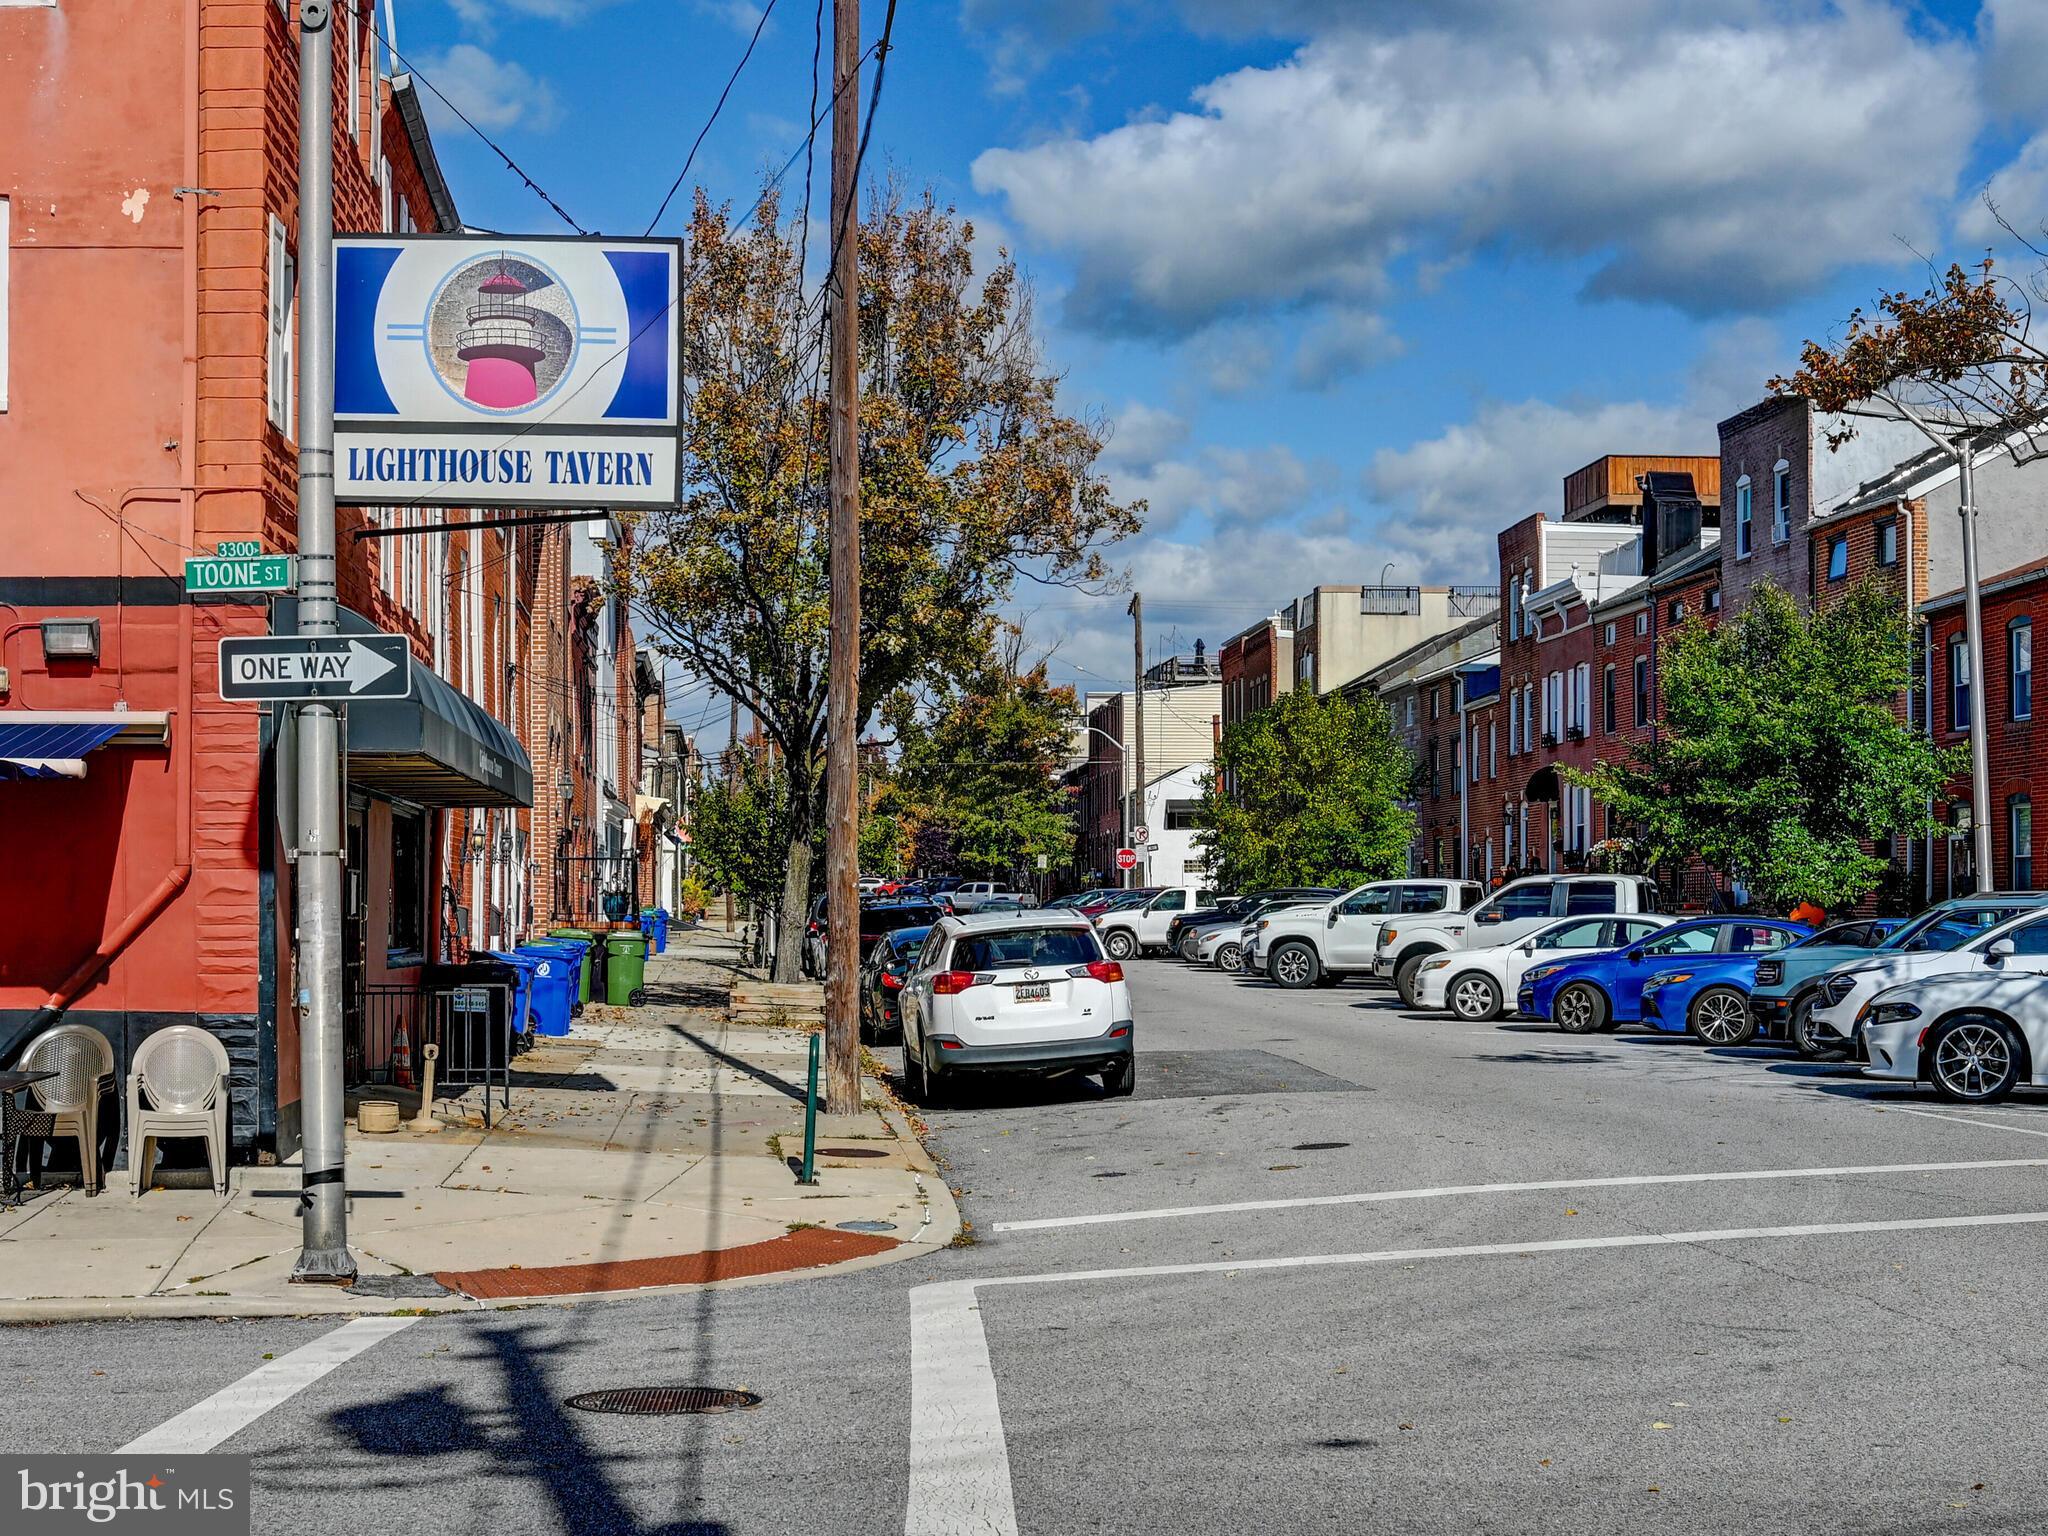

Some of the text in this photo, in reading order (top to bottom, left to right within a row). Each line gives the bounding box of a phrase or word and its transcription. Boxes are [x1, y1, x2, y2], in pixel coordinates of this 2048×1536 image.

[348, 447, 654, 486] LIGHTHOUSE TAVERN
[219, 542, 254, 557] 3300
[193, 562, 262, 587] TOONE
[241, 655, 351, 680] ONE WAY
[1117, 854, 1136, 863] STOP
